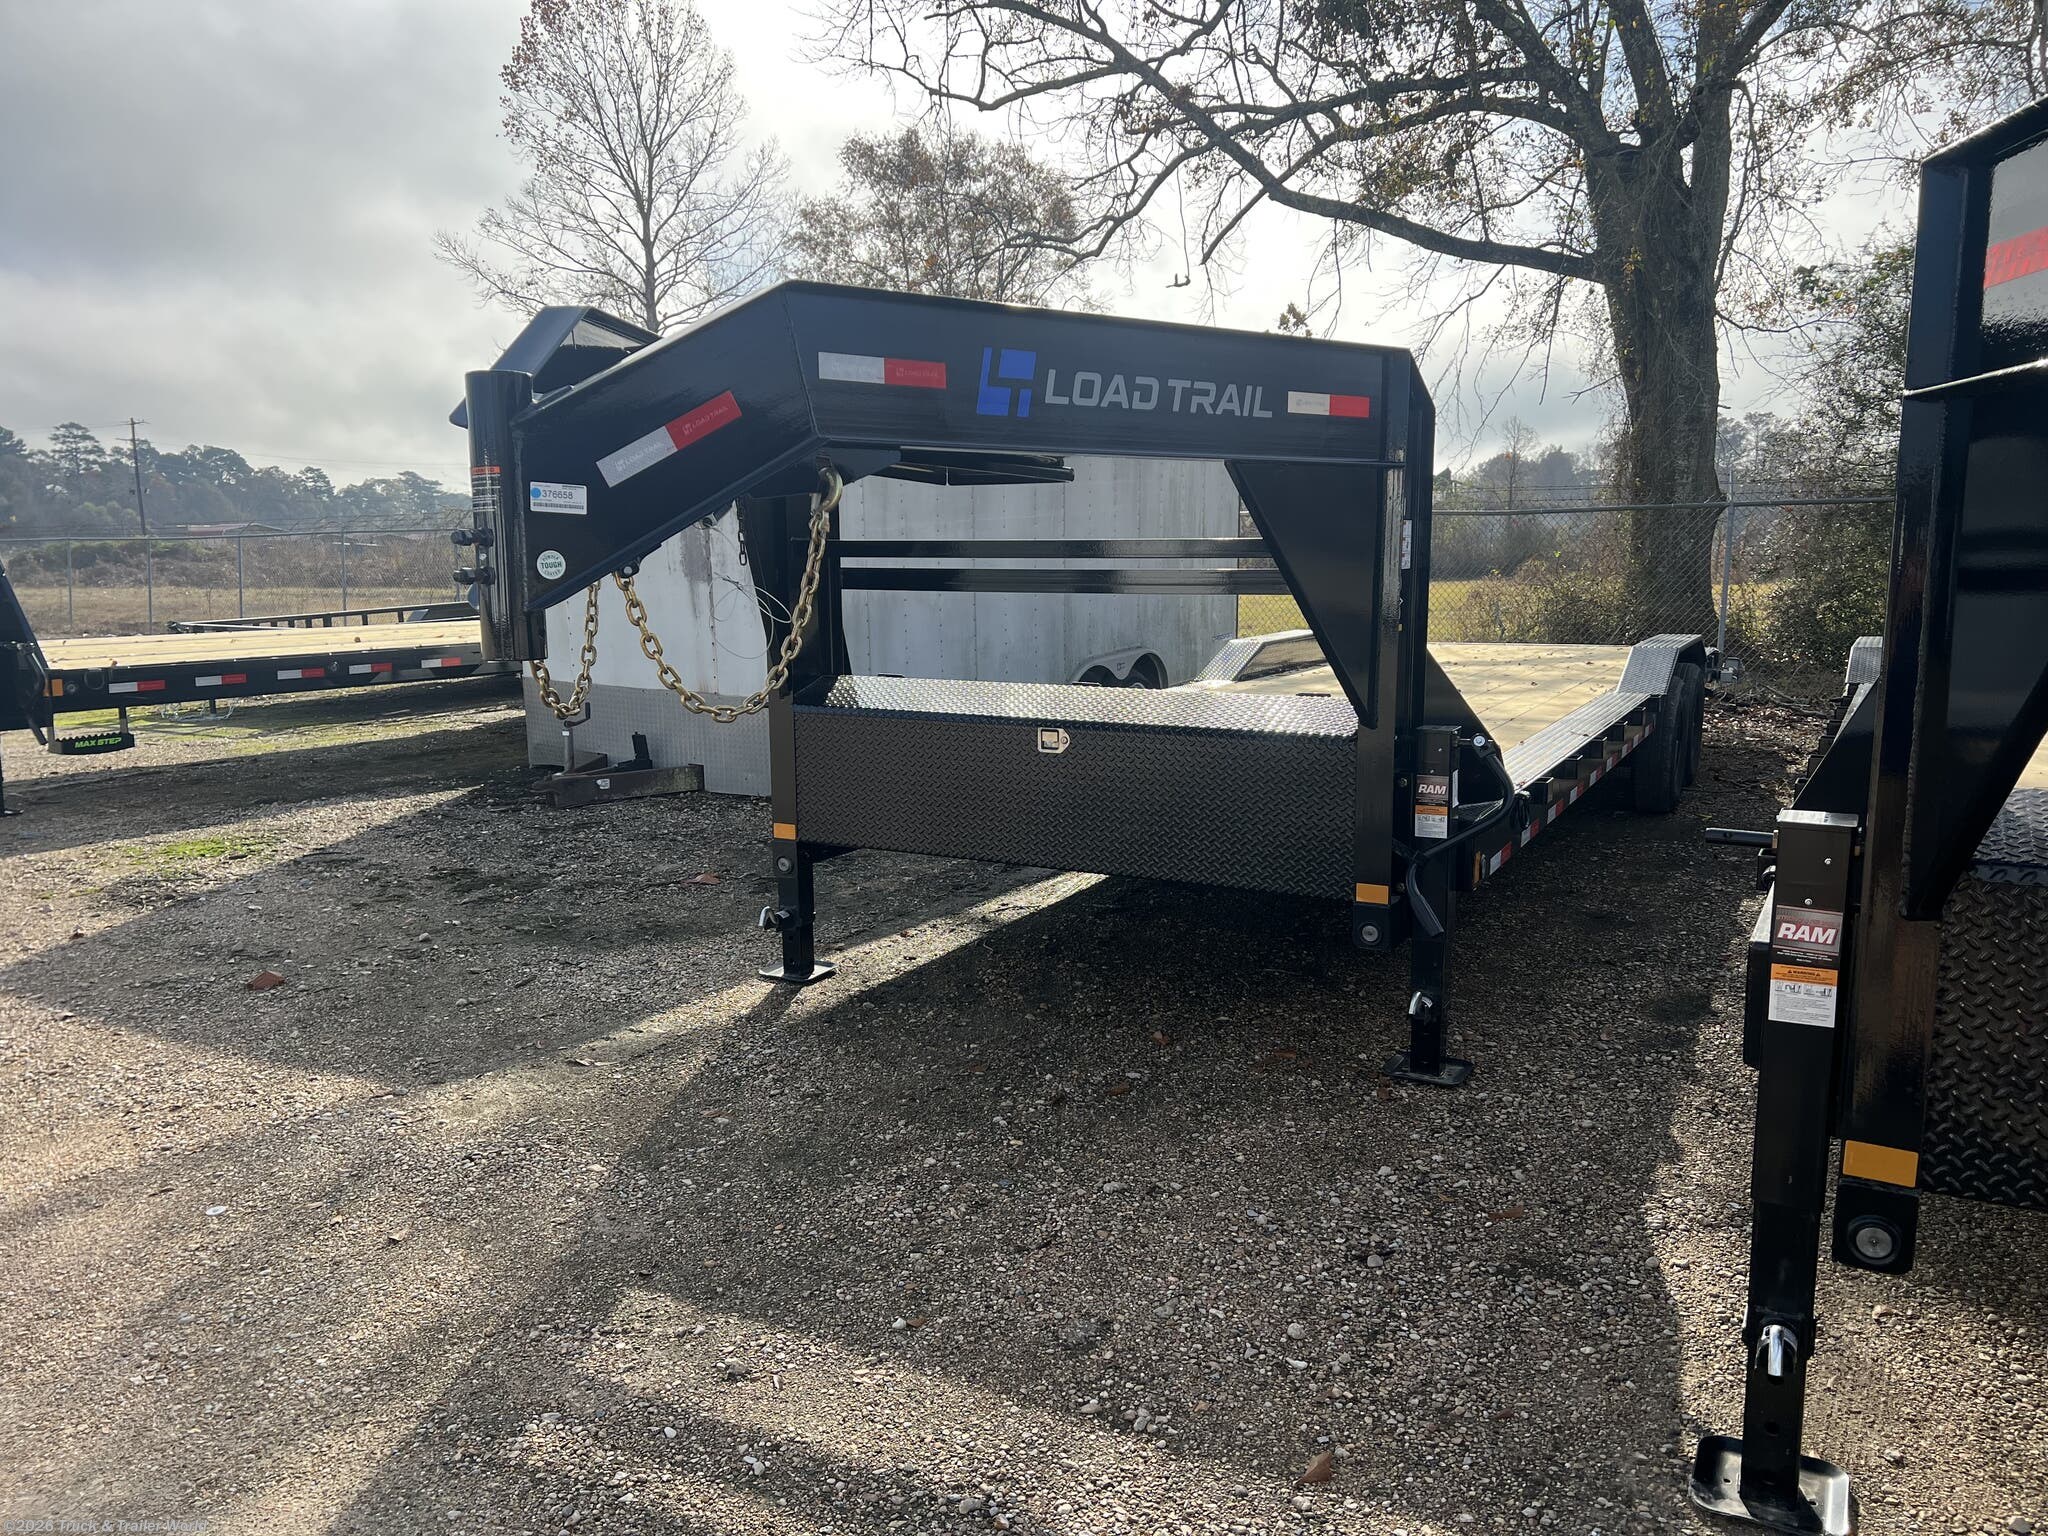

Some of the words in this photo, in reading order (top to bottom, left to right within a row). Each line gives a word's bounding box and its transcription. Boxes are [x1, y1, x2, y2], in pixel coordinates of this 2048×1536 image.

[1045, 368, 1160, 411] LOAD
[1167, 378, 1273, 418] TRAIL
[542, 489, 574, 500] 376658
[540, 561, 562, 569] TOUGH
[74, 740, 96, 749] MAX
[97, 737, 122, 746] STEP
[1418, 784, 1447, 795] RAM
[1777, 922, 1837, 945] RAM
